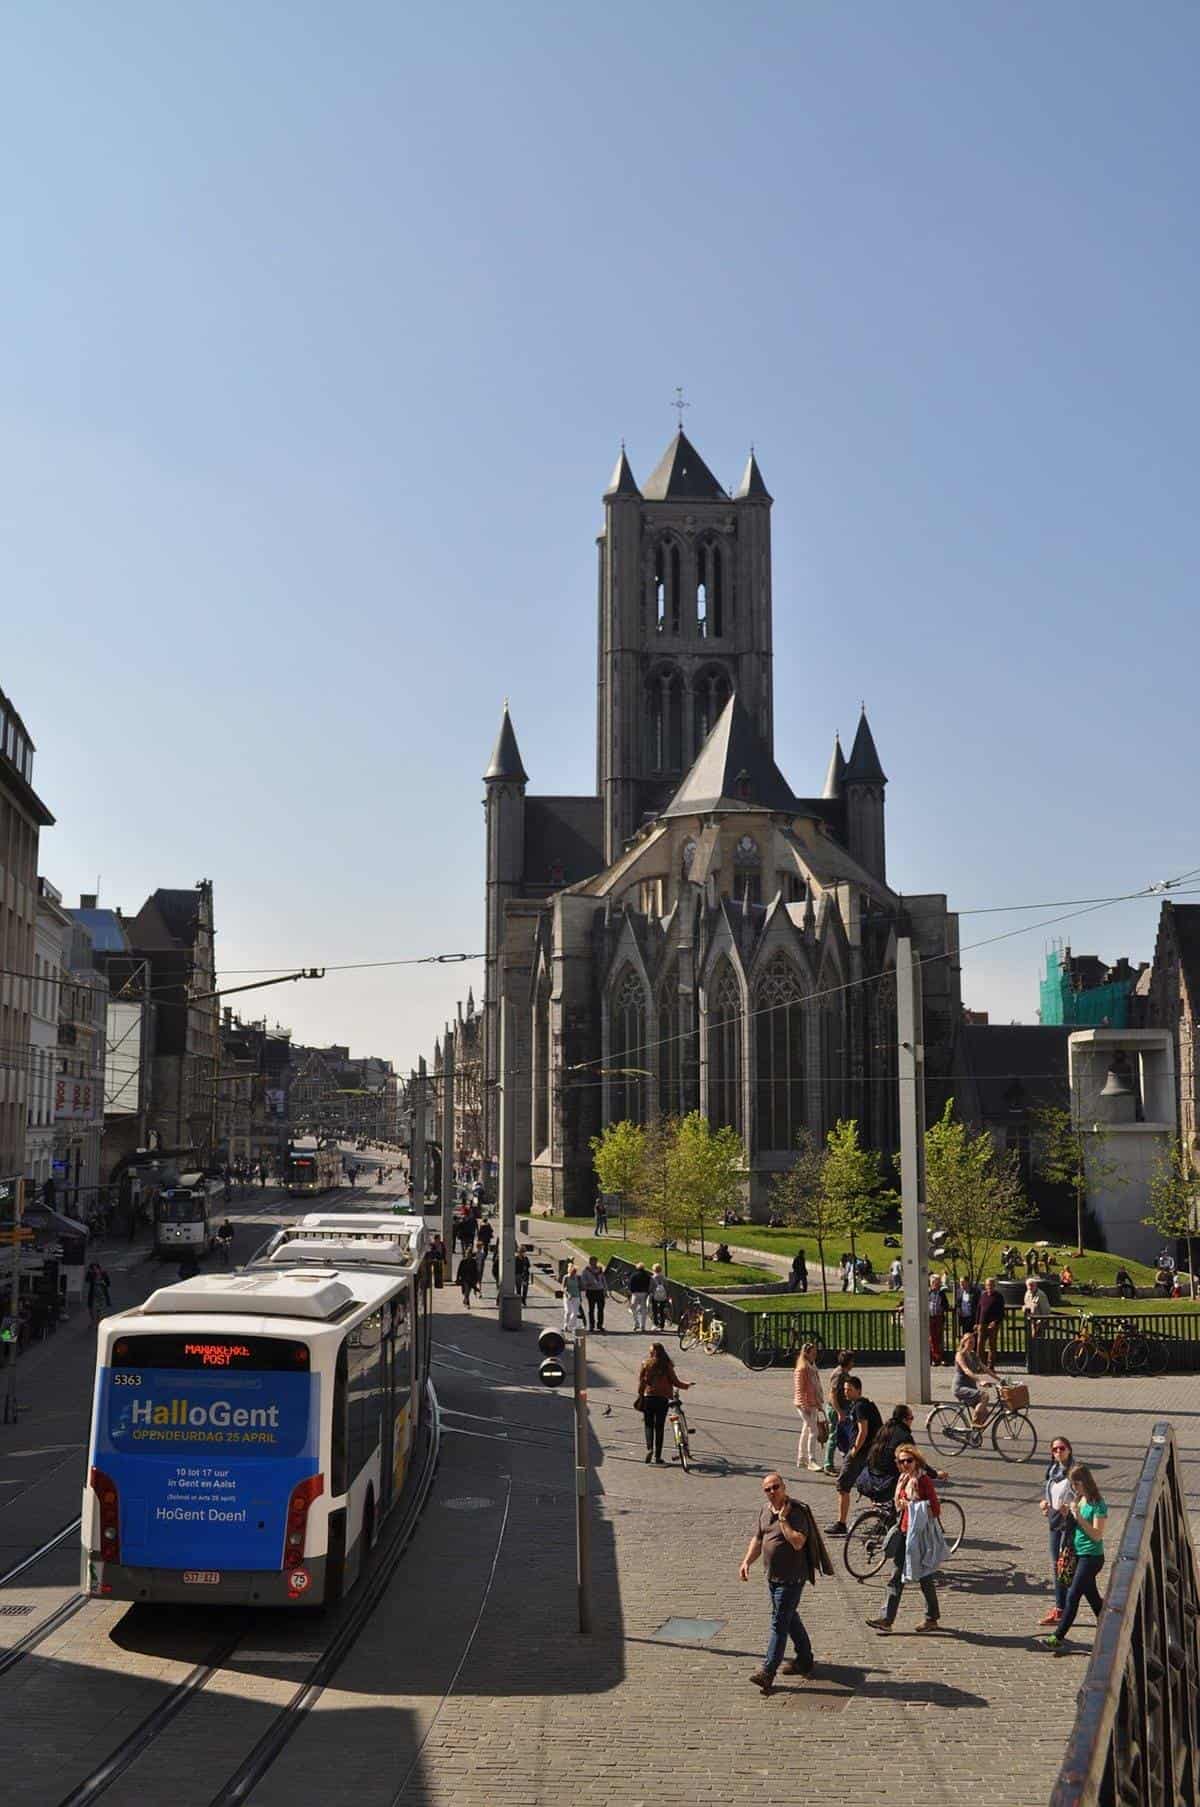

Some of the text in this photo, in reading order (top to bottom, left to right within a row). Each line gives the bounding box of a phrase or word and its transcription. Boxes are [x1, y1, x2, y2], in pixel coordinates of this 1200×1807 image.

[203, 1354, 231, 1365] POST
[113, 1374, 142, 1386] 5363
[131, 1399, 280, 1427] HalloGent
[133, 1429, 277, 1444] OPENDEURDAG 25 APRIL
[176, 1467, 186, 1477] 10
[202, 1468, 212, 1478] 17
[214, 1469, 230, 1478] uur
[178, 1478, 199, 1488] Gent
[201, 1480, 212, 1488] en
[213, 1479, 237, 1489] Aalst
[156, 1506, 247, 1522] HoGent Doen!
[293, 1574, 306, 1584] 75
